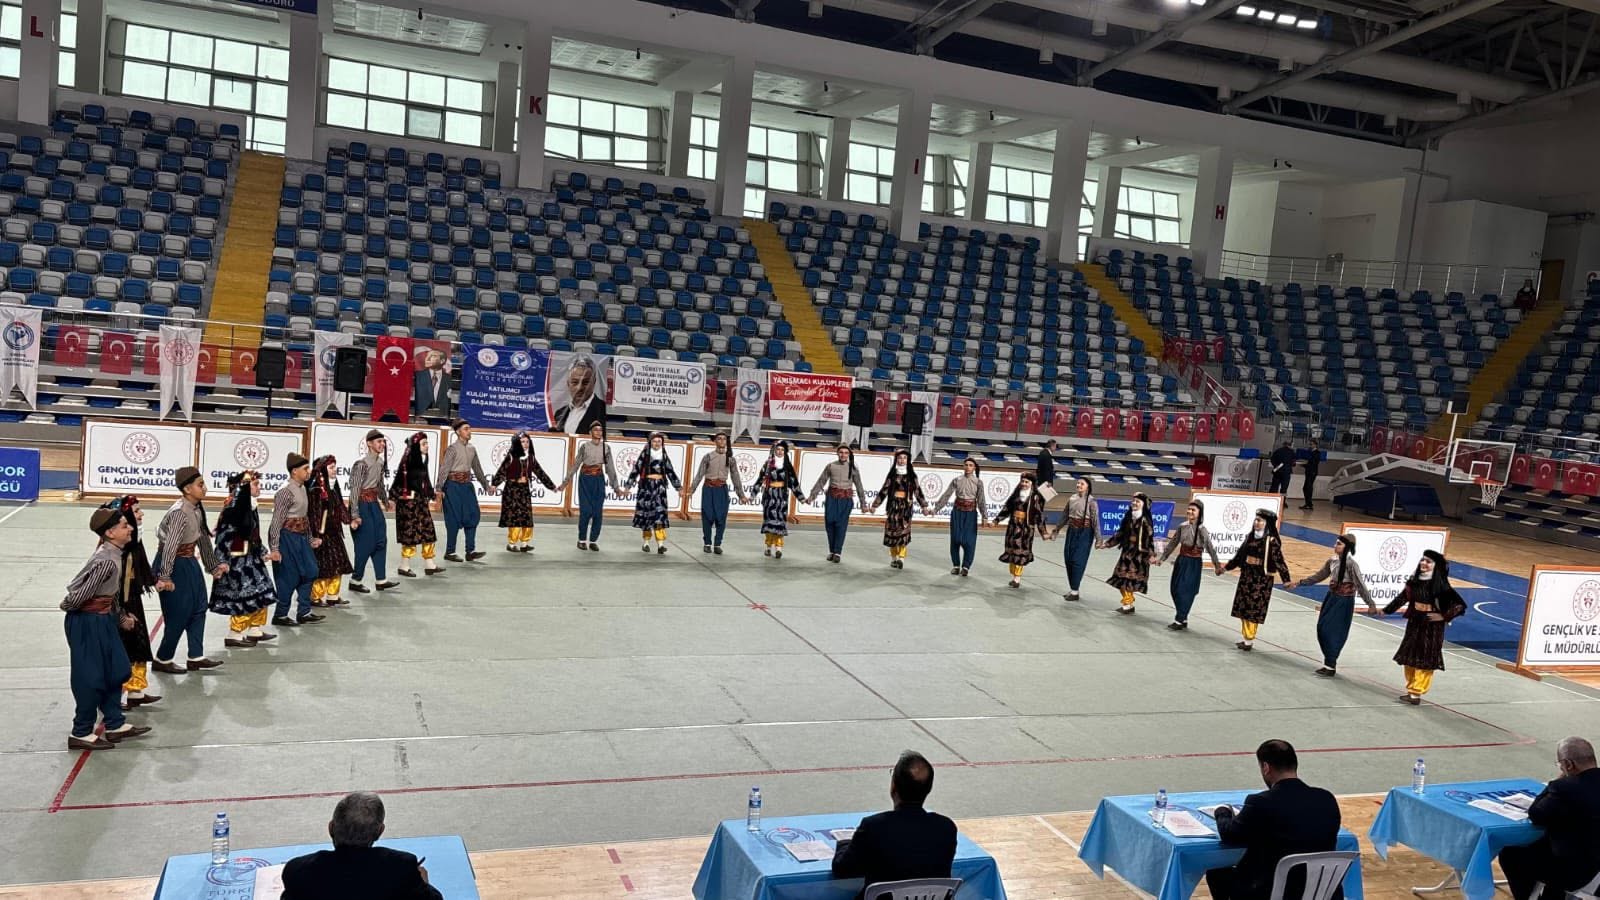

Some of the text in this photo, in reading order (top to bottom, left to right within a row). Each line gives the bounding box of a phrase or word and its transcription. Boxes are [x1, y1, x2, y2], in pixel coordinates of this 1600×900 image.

[30, 15, 44, 38] L
[529, 95, 542, 115] K
[1215, 204, 1225, 220] H
[633, 377, 689, 389] KULÜPLER ARASI
[773, 376, 850, 389] YARIŞMACI KULÜPLERE
[465, 390, 488, 398] KULÜP
[488, 385, 521, 394] KATILIMCI
[632, 385, 651, 393] GRUP
[470, 398, 535, 410] BAŞARILAR DİLERİM
[640, 397, 677, 406] MALATYA
[0, 466, 26, 477] POR
[97, 464, 176, 476] GENÇLİK VE SPO
[100, 475, 110, 485] İL
[213, 479, 222, 489] İL
[863, 490, 880, 498] POR
[1151, 513, 1168, 522] POR
[1103, 521, 1111, 531] İL
[1233, 533, 1244, 542] VE
[1391, 574, 1403, 584] VE
[1542, 622, 1584, 638] GENÇLİK
[1585, 624, 1598, 636] VE
[1543, 640, 1552, 654] İL
